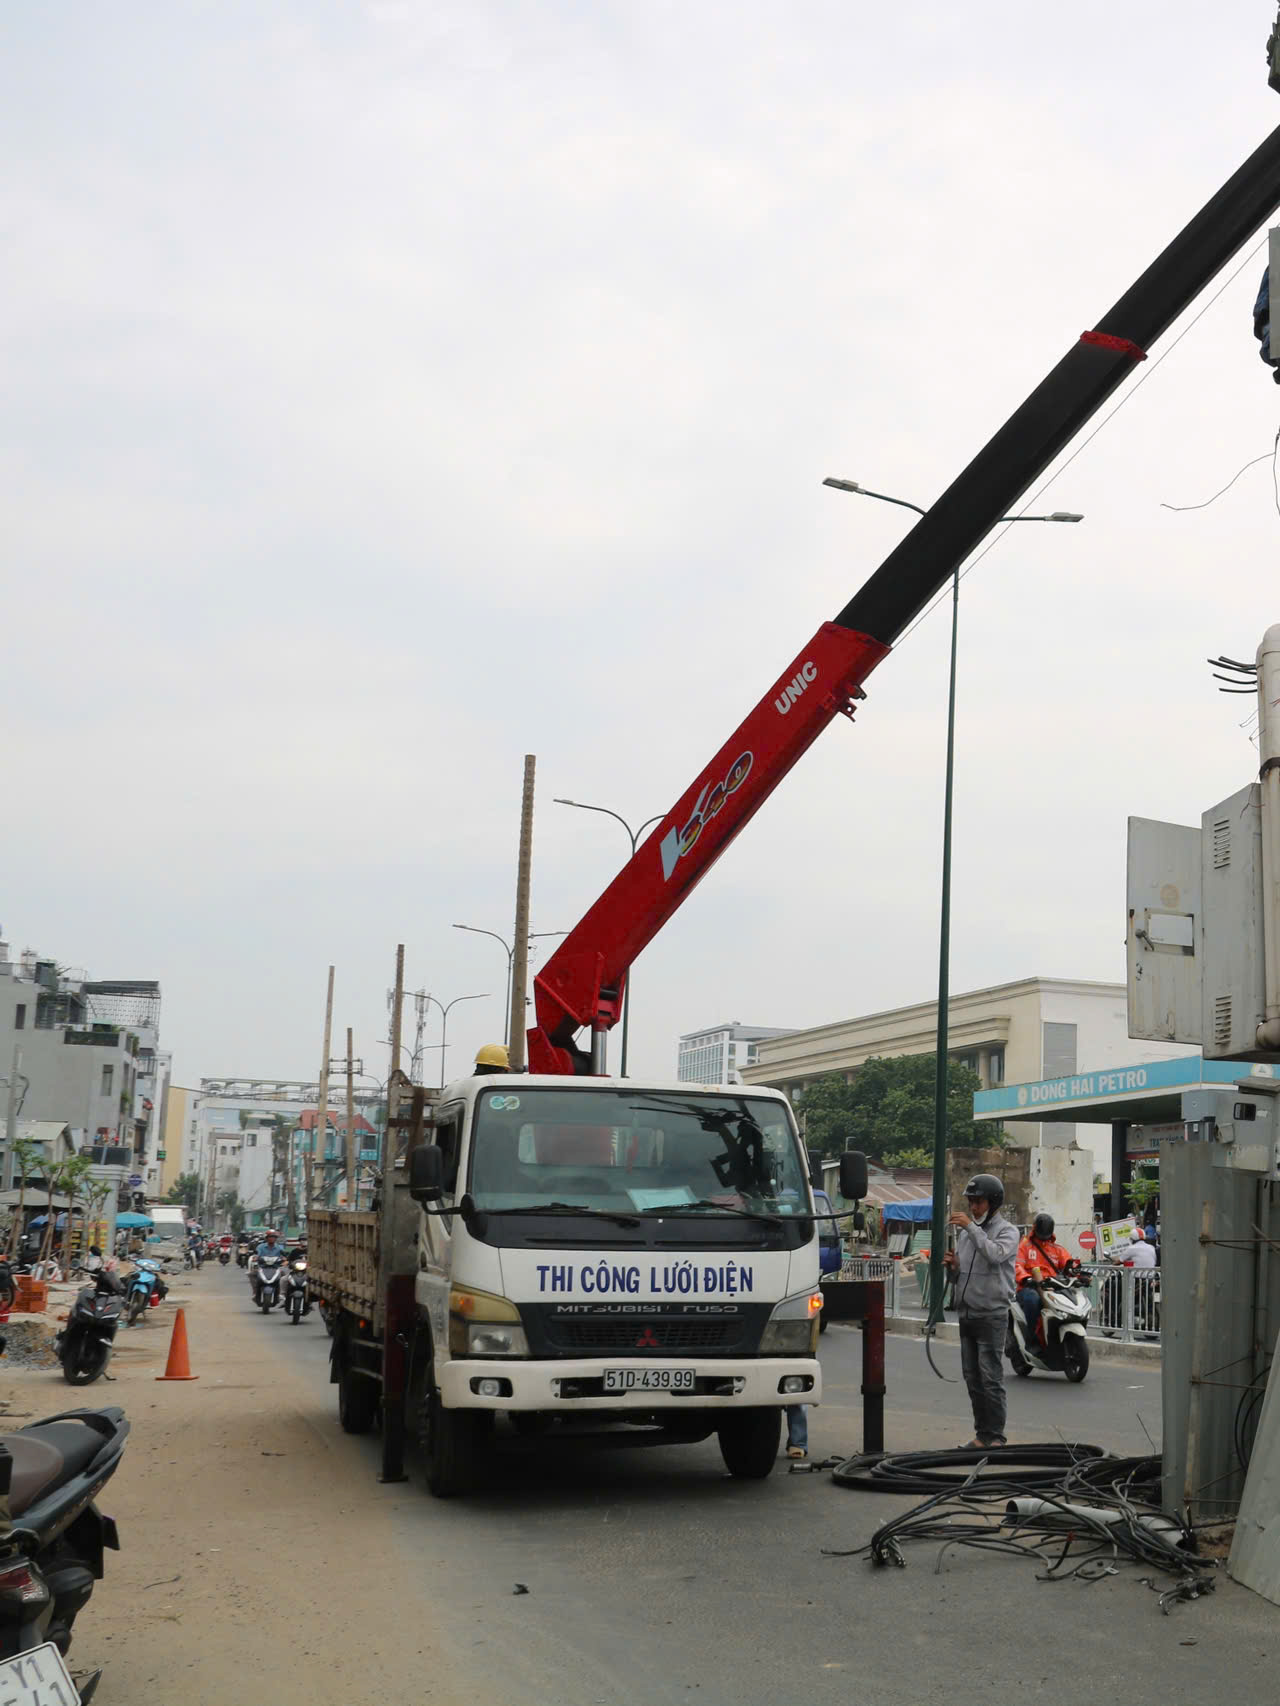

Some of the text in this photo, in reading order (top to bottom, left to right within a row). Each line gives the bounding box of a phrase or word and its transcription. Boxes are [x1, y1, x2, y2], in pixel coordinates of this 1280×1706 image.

[774, 661, 818, 715] UNIC
[1031, 1069, 1148, 1102] DONG HAI PETRO
[536, 1259, 753, 1298] THI CÔNG LƯỚI ĐIỆN
[606, 1371, 693, 1388] 51D-439.99
